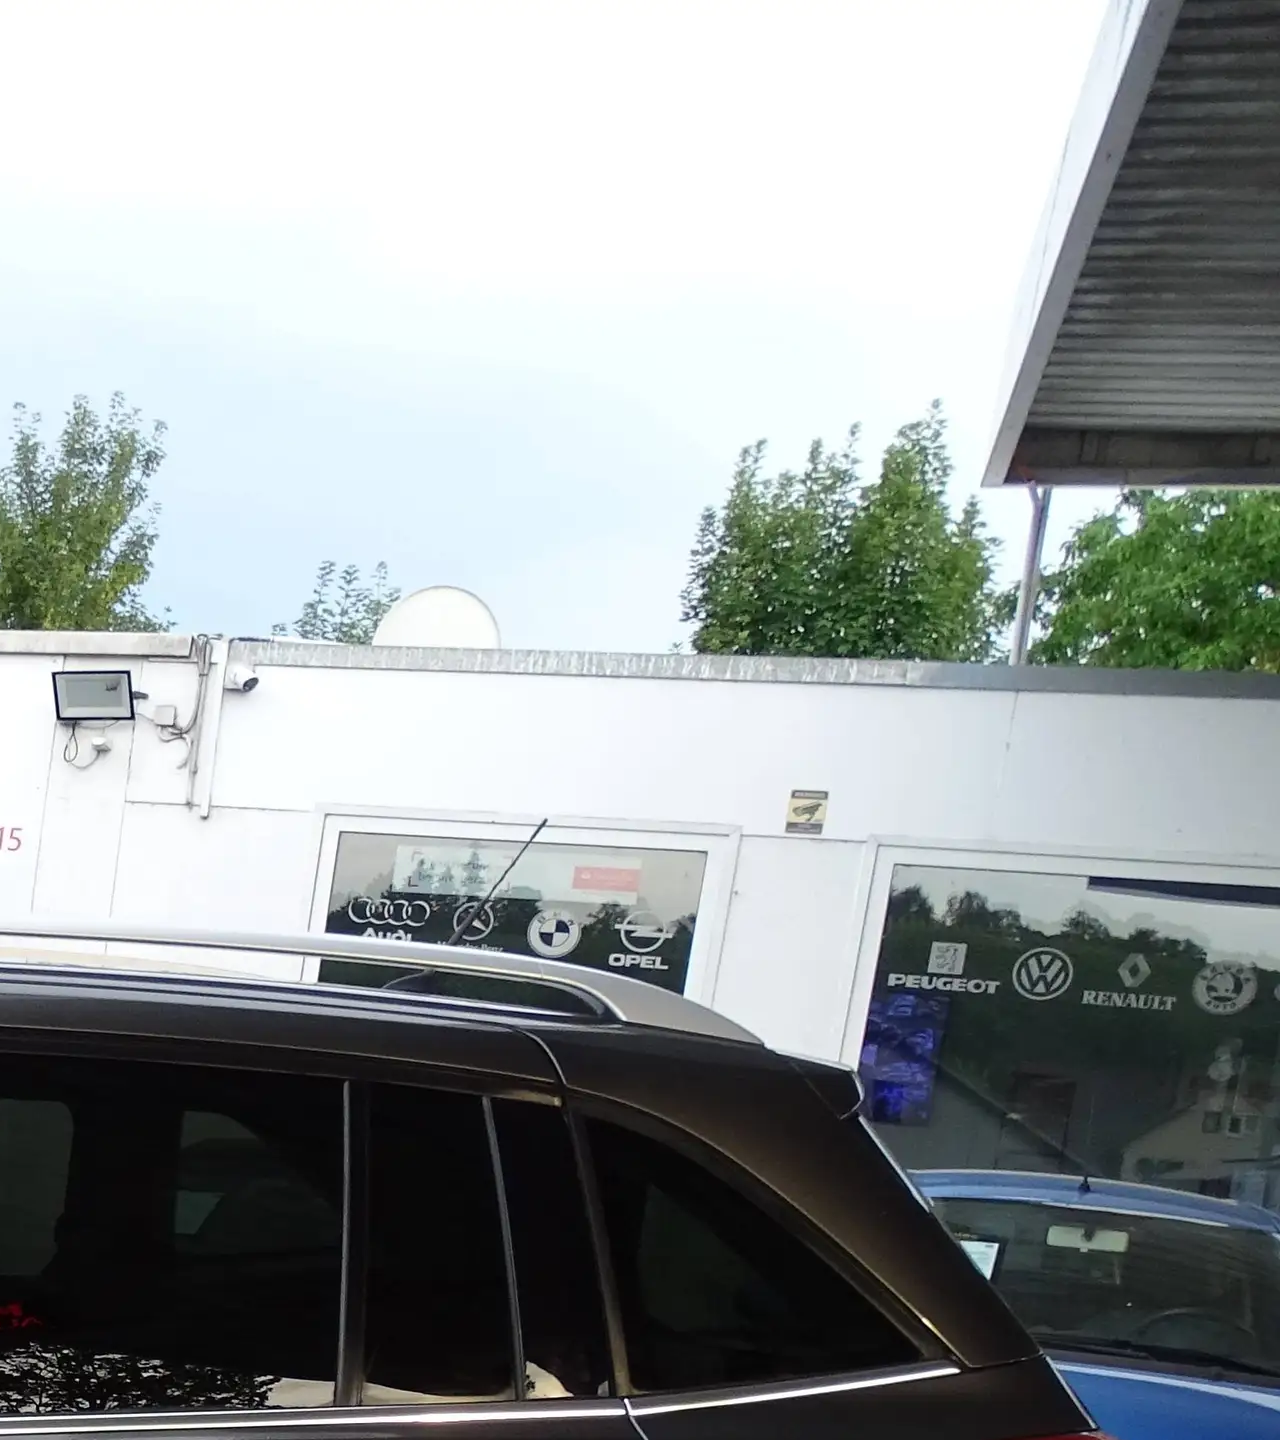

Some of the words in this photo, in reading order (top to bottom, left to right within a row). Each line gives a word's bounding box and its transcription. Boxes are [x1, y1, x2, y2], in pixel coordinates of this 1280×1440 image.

[608, 953, 669, 970] OPEL
[887, 973, 1000, 995] PEUGEOT
[1081, 990, 1177, 1011] RENAULT
